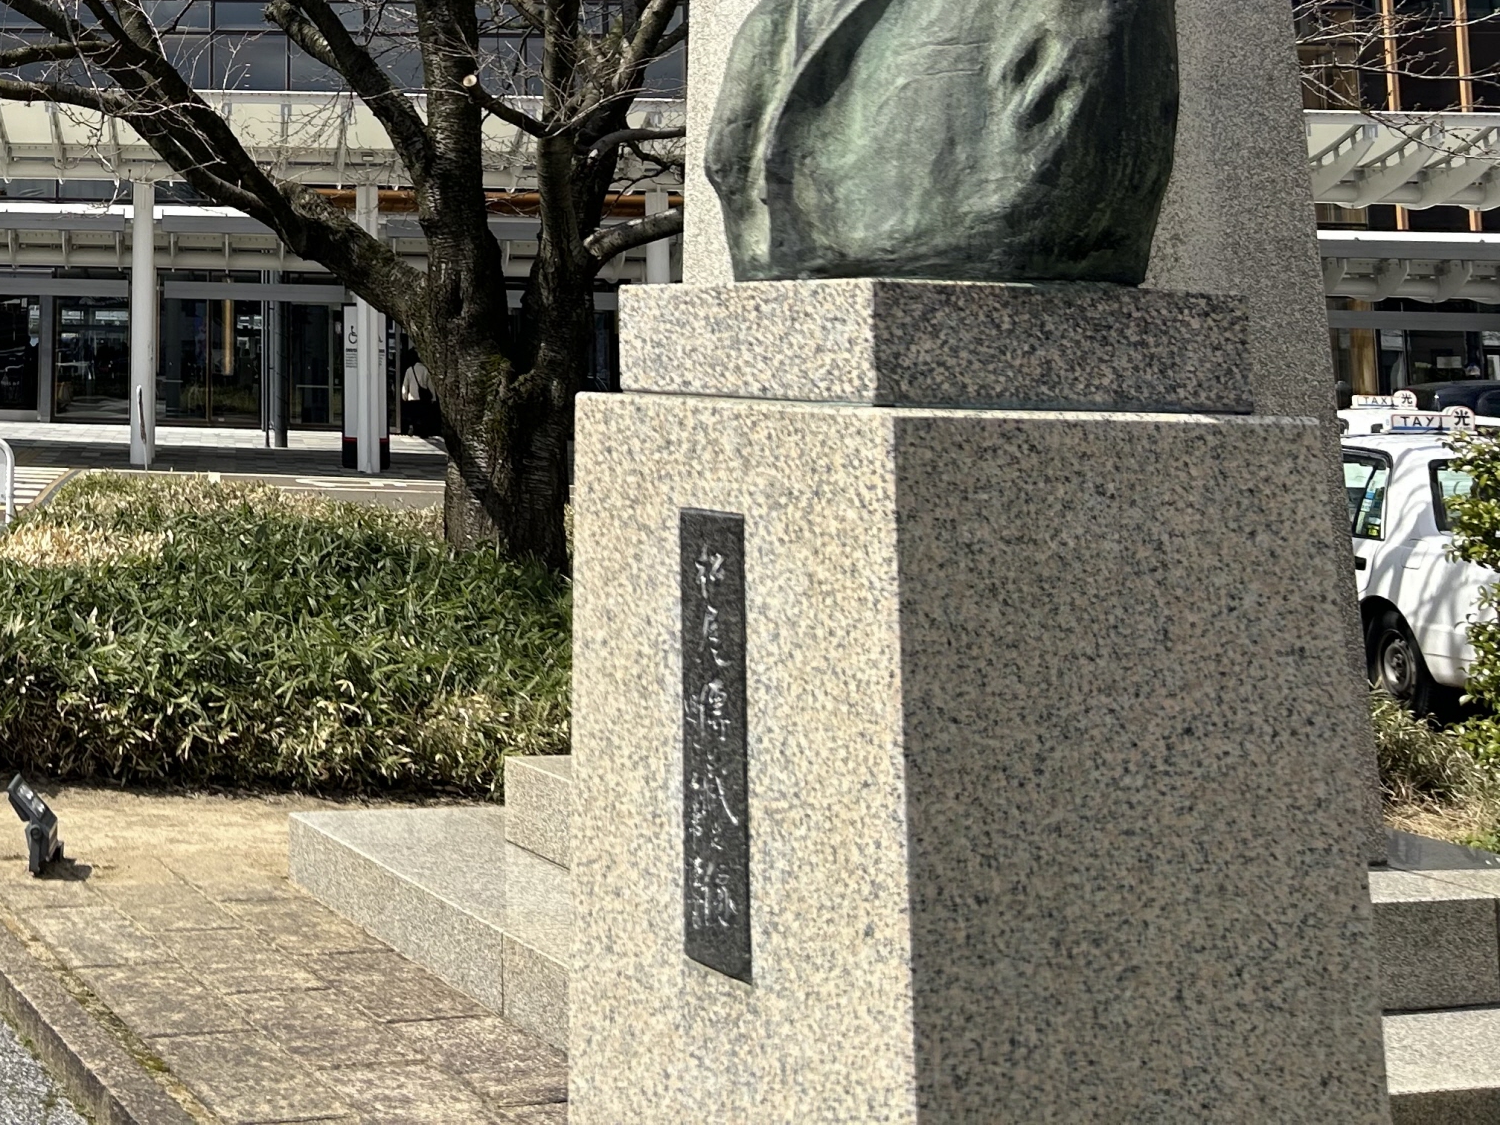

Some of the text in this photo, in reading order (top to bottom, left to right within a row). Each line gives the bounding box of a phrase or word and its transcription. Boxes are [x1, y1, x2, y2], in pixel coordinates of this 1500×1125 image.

[1362, 396, 1394, 405] TAX
[1400, 409, 1471, 427] TAX 光
